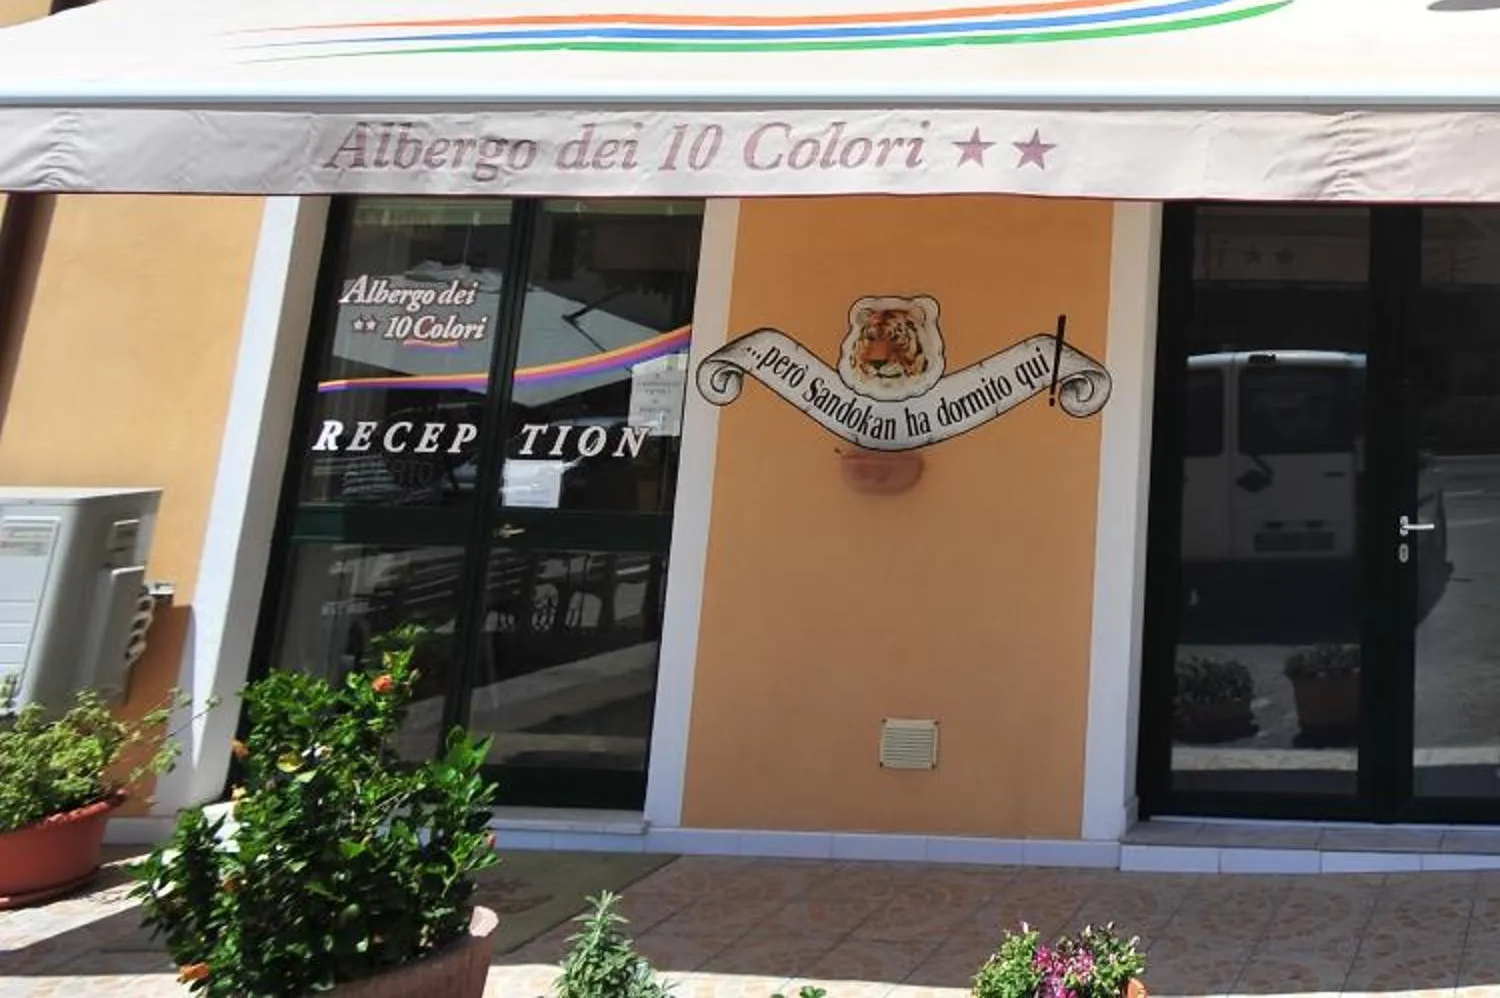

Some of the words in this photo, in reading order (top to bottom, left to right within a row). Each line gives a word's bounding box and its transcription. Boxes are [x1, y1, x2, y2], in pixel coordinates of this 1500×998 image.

[321, 121, 539, 182] Albergo
[555, 120, 639, 172] dei
[656, 122, 724, 173] 10
[742, 119, 933, 172] Colori
[338, 274, 436, 312] Albergo
[438, 281, 478, 305] dei
[383, 316, 412, 340] 10
[412, 315, 489, 341] Colori
[802, 376, 899, 441] Sandokan
[904, 407, 932, 438] ha
[936, 372, 1014, 429] dormito
